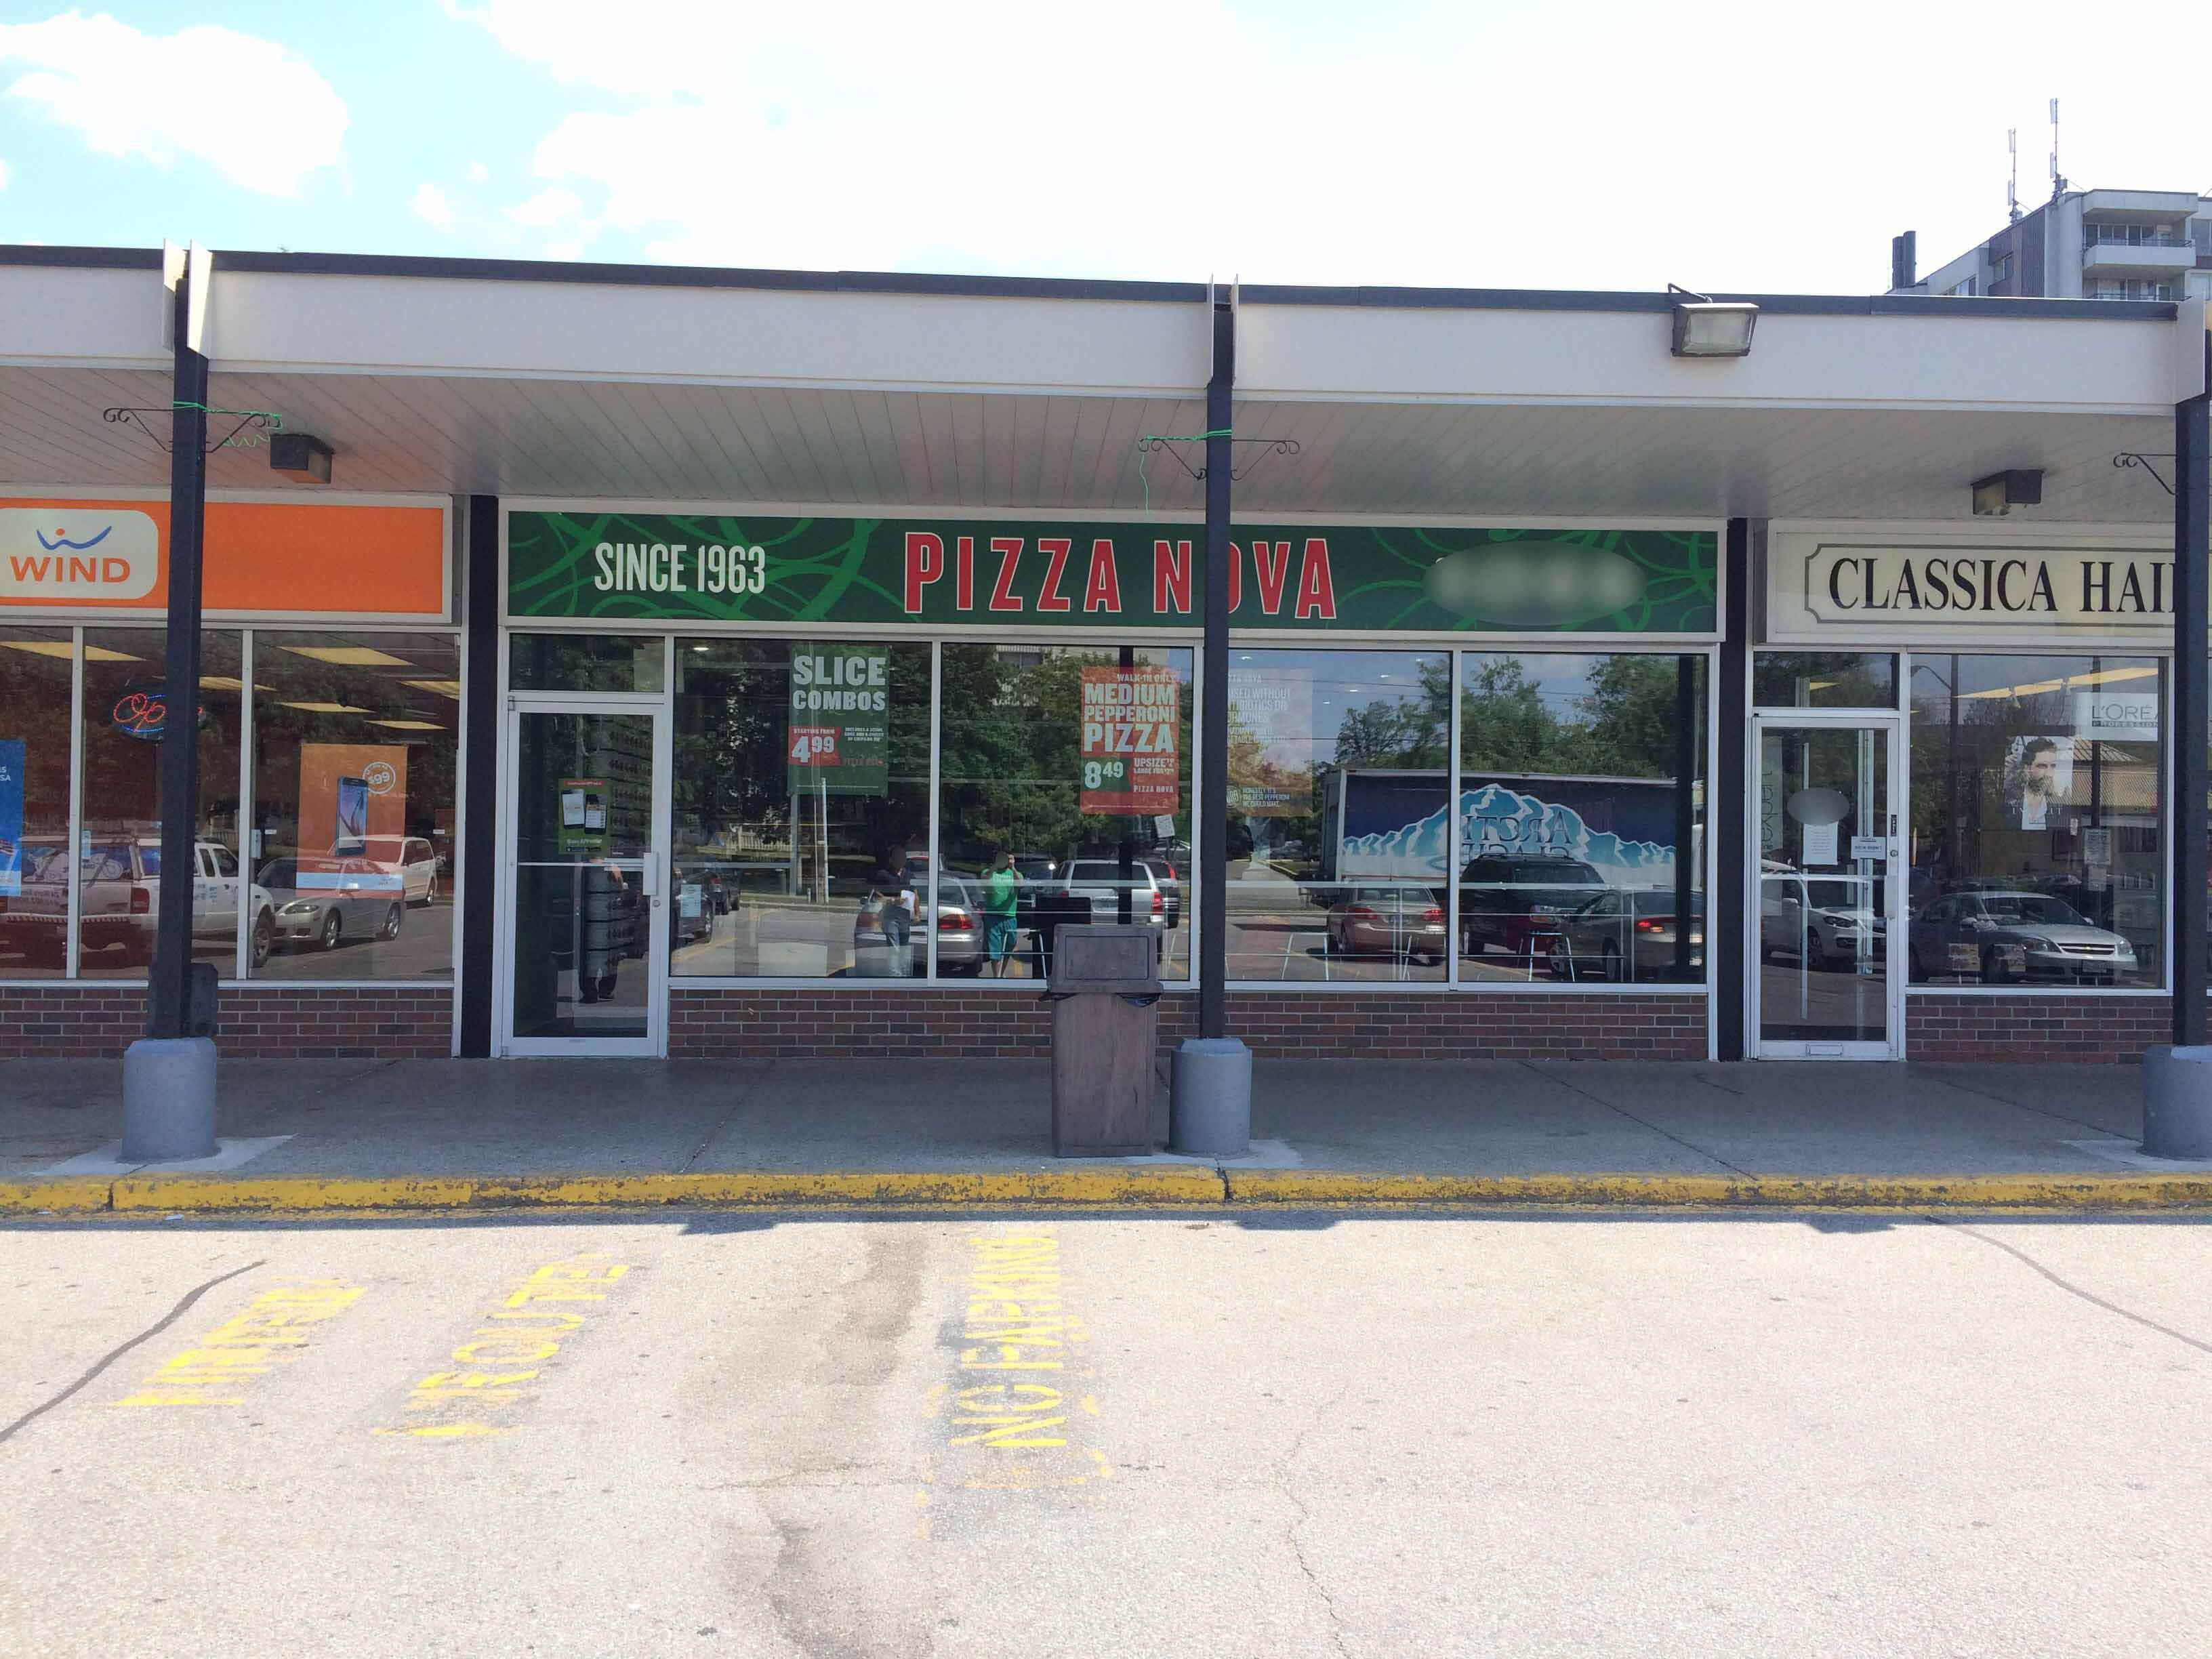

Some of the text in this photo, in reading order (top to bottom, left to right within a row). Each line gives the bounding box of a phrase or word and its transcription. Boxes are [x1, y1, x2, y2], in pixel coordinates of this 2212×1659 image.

[9, 556, 131, 583] WIND
[594, 542, 765, 594] SINCE 1963
[905, 532, 1122, 613] PIZZA
[1829, 558, 2175, 613] CLASSICA HAI
[793, 655, 886, 686] SLICE
[1117, 674, 1152, 682] WALK-IN
[793, 690, 886, 711] COMBOS
[1084, 682, 1175, 705] MEDIUM
[113, 693, 203, 732] Op
[1084, 705, 1175, 722] PEPPERONI
[1084, 723, 1174, 752] PIZZA
[1134, 758, 1166, 768] UPSIZE
